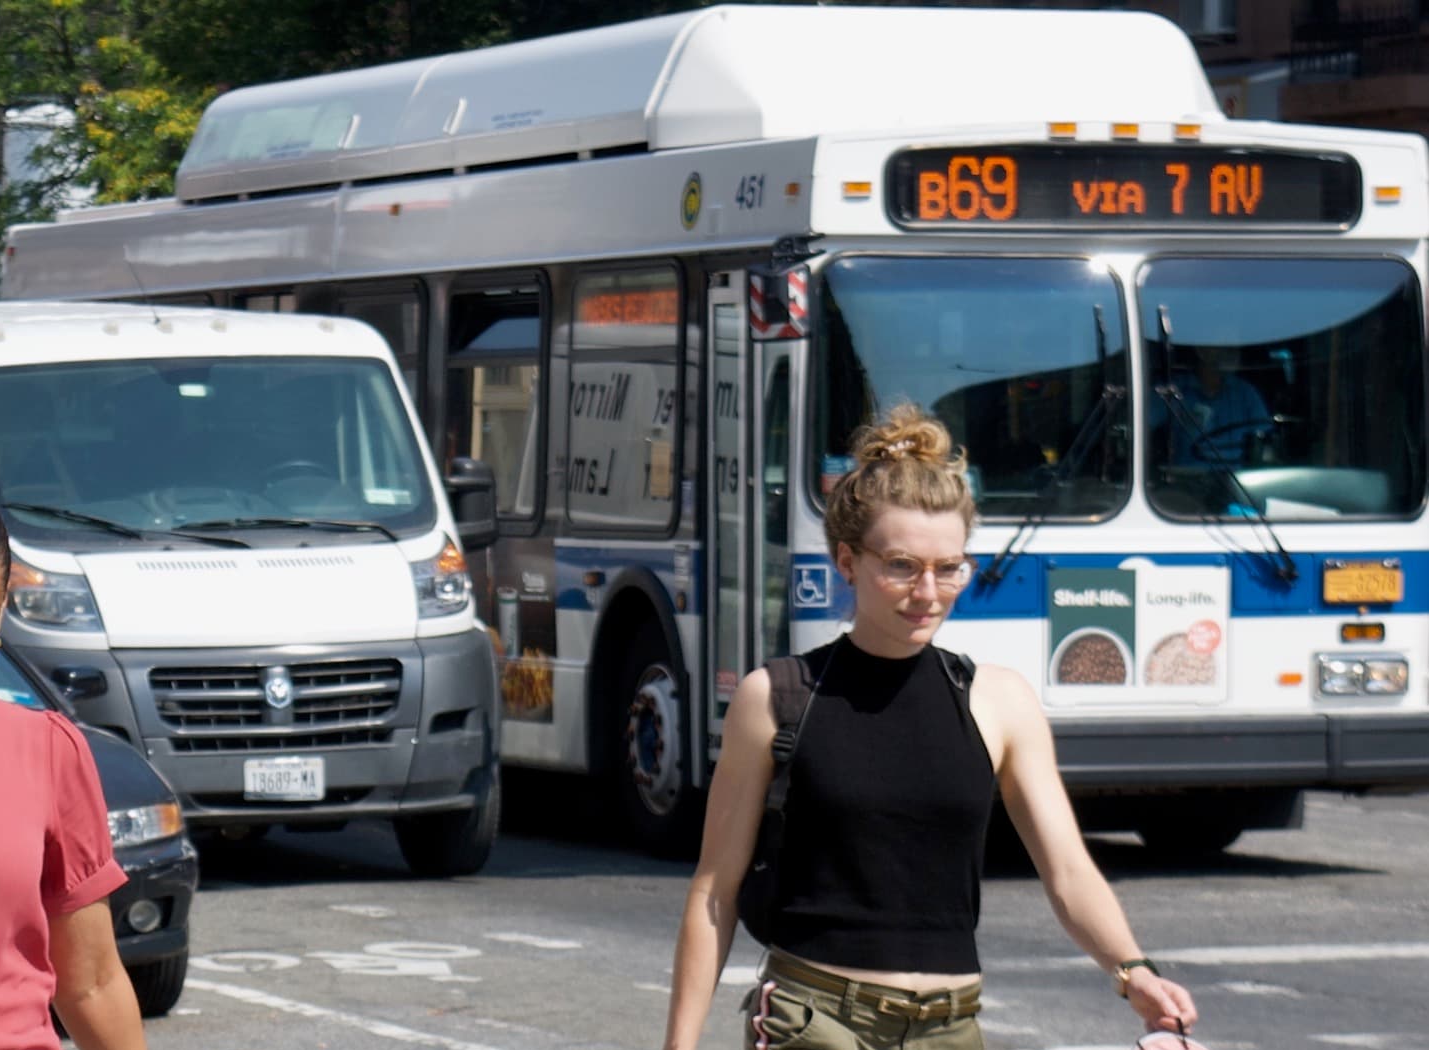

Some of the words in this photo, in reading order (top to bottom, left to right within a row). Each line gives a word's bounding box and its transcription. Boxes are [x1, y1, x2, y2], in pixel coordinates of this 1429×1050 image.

[736, 173, 765, 209] 451
[918, 155, 1017, 220] B69
[1071, 181, 1145, 215] VIA
[1165, 163, 1190, 215] 7
[1210, 163, 1264, 215] AV
